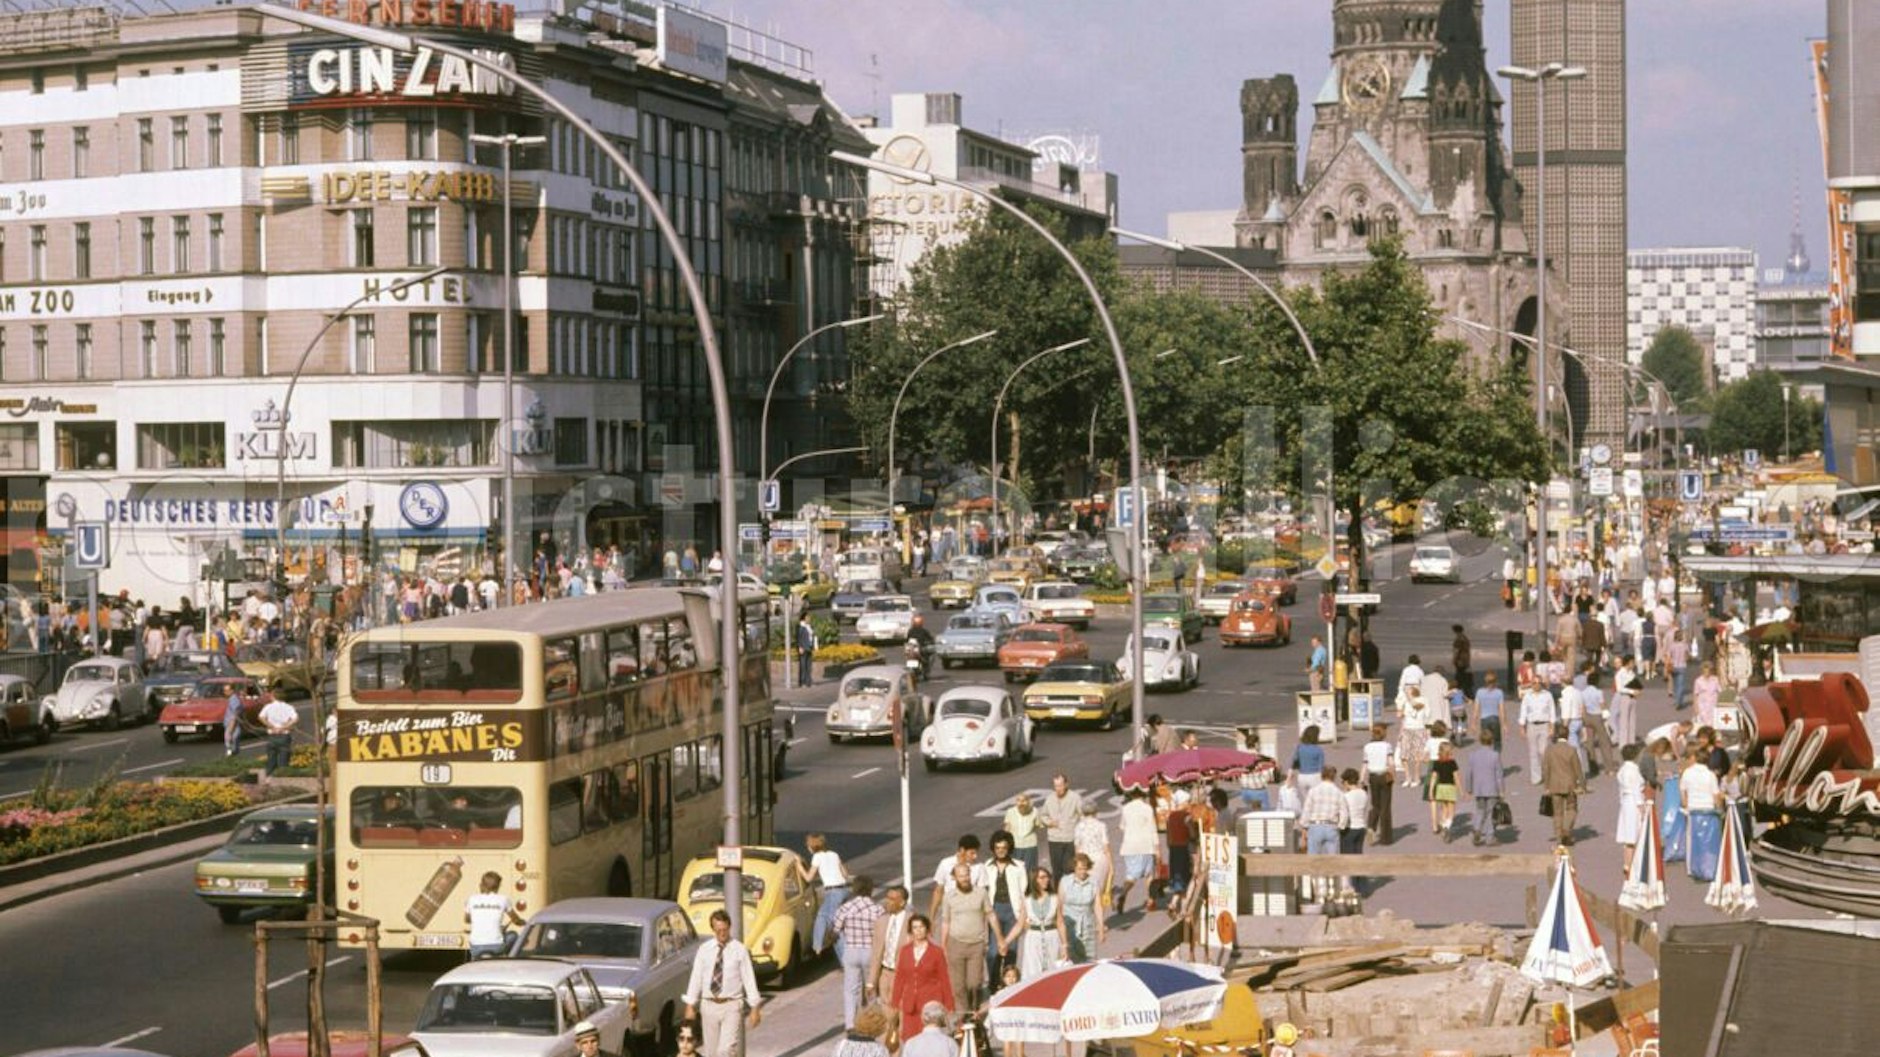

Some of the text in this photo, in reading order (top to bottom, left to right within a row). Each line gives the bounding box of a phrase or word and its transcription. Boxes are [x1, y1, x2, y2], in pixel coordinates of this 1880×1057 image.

[308, 46, 517, 96] CINZANO
[30, 290, 75, 314] ZOO
[147, 289, 201, 305] Eingang
[363, 277, 473, 303] HOTEL
[233, 432, 317, 460] KLM
[1683, 474, 1699, 499] U
[104, 495, 349, 524] DEUTSCHES REISÜR
[411, 491, 434, 519] DER
[79, 527, 101, 562] U
[356, 711, 485, 736] Bestell zum Bier
[350, 722, 523, 761] KABÄNES
[491, 747, 517, 762] Dir
[426, 766, 440, 782] 19
[1203, 835, 1230, 865] EIS
[1062, 1015, 1097, 1034] LORD
[1123, 1010, 1159, 1028] EXTRA
